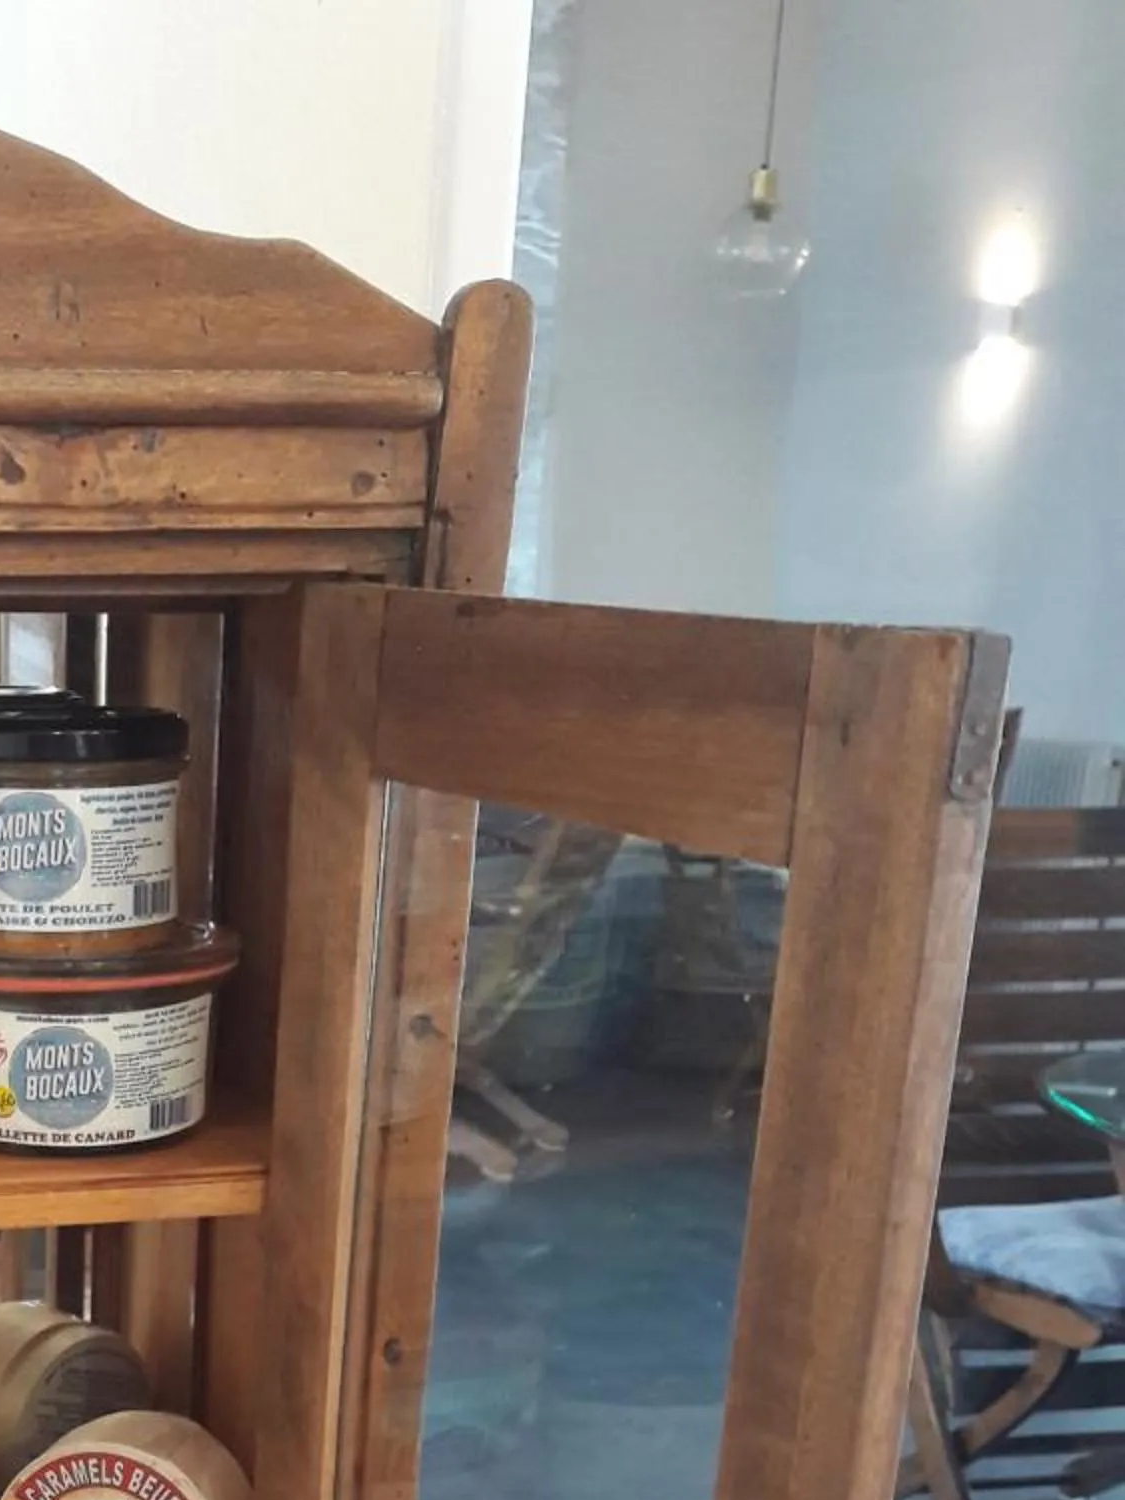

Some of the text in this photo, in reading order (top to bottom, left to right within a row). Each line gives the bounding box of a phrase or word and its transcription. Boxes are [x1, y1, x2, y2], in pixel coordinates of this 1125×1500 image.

[22, 902, 45, 914] DE
[25, 1041, 95, 1072] MONTS
[26, 1067, 105, 1101] BOCAUX
[52, 1132, 71, 1144] DE
[74, 1129, 136, 1144] CANARD
